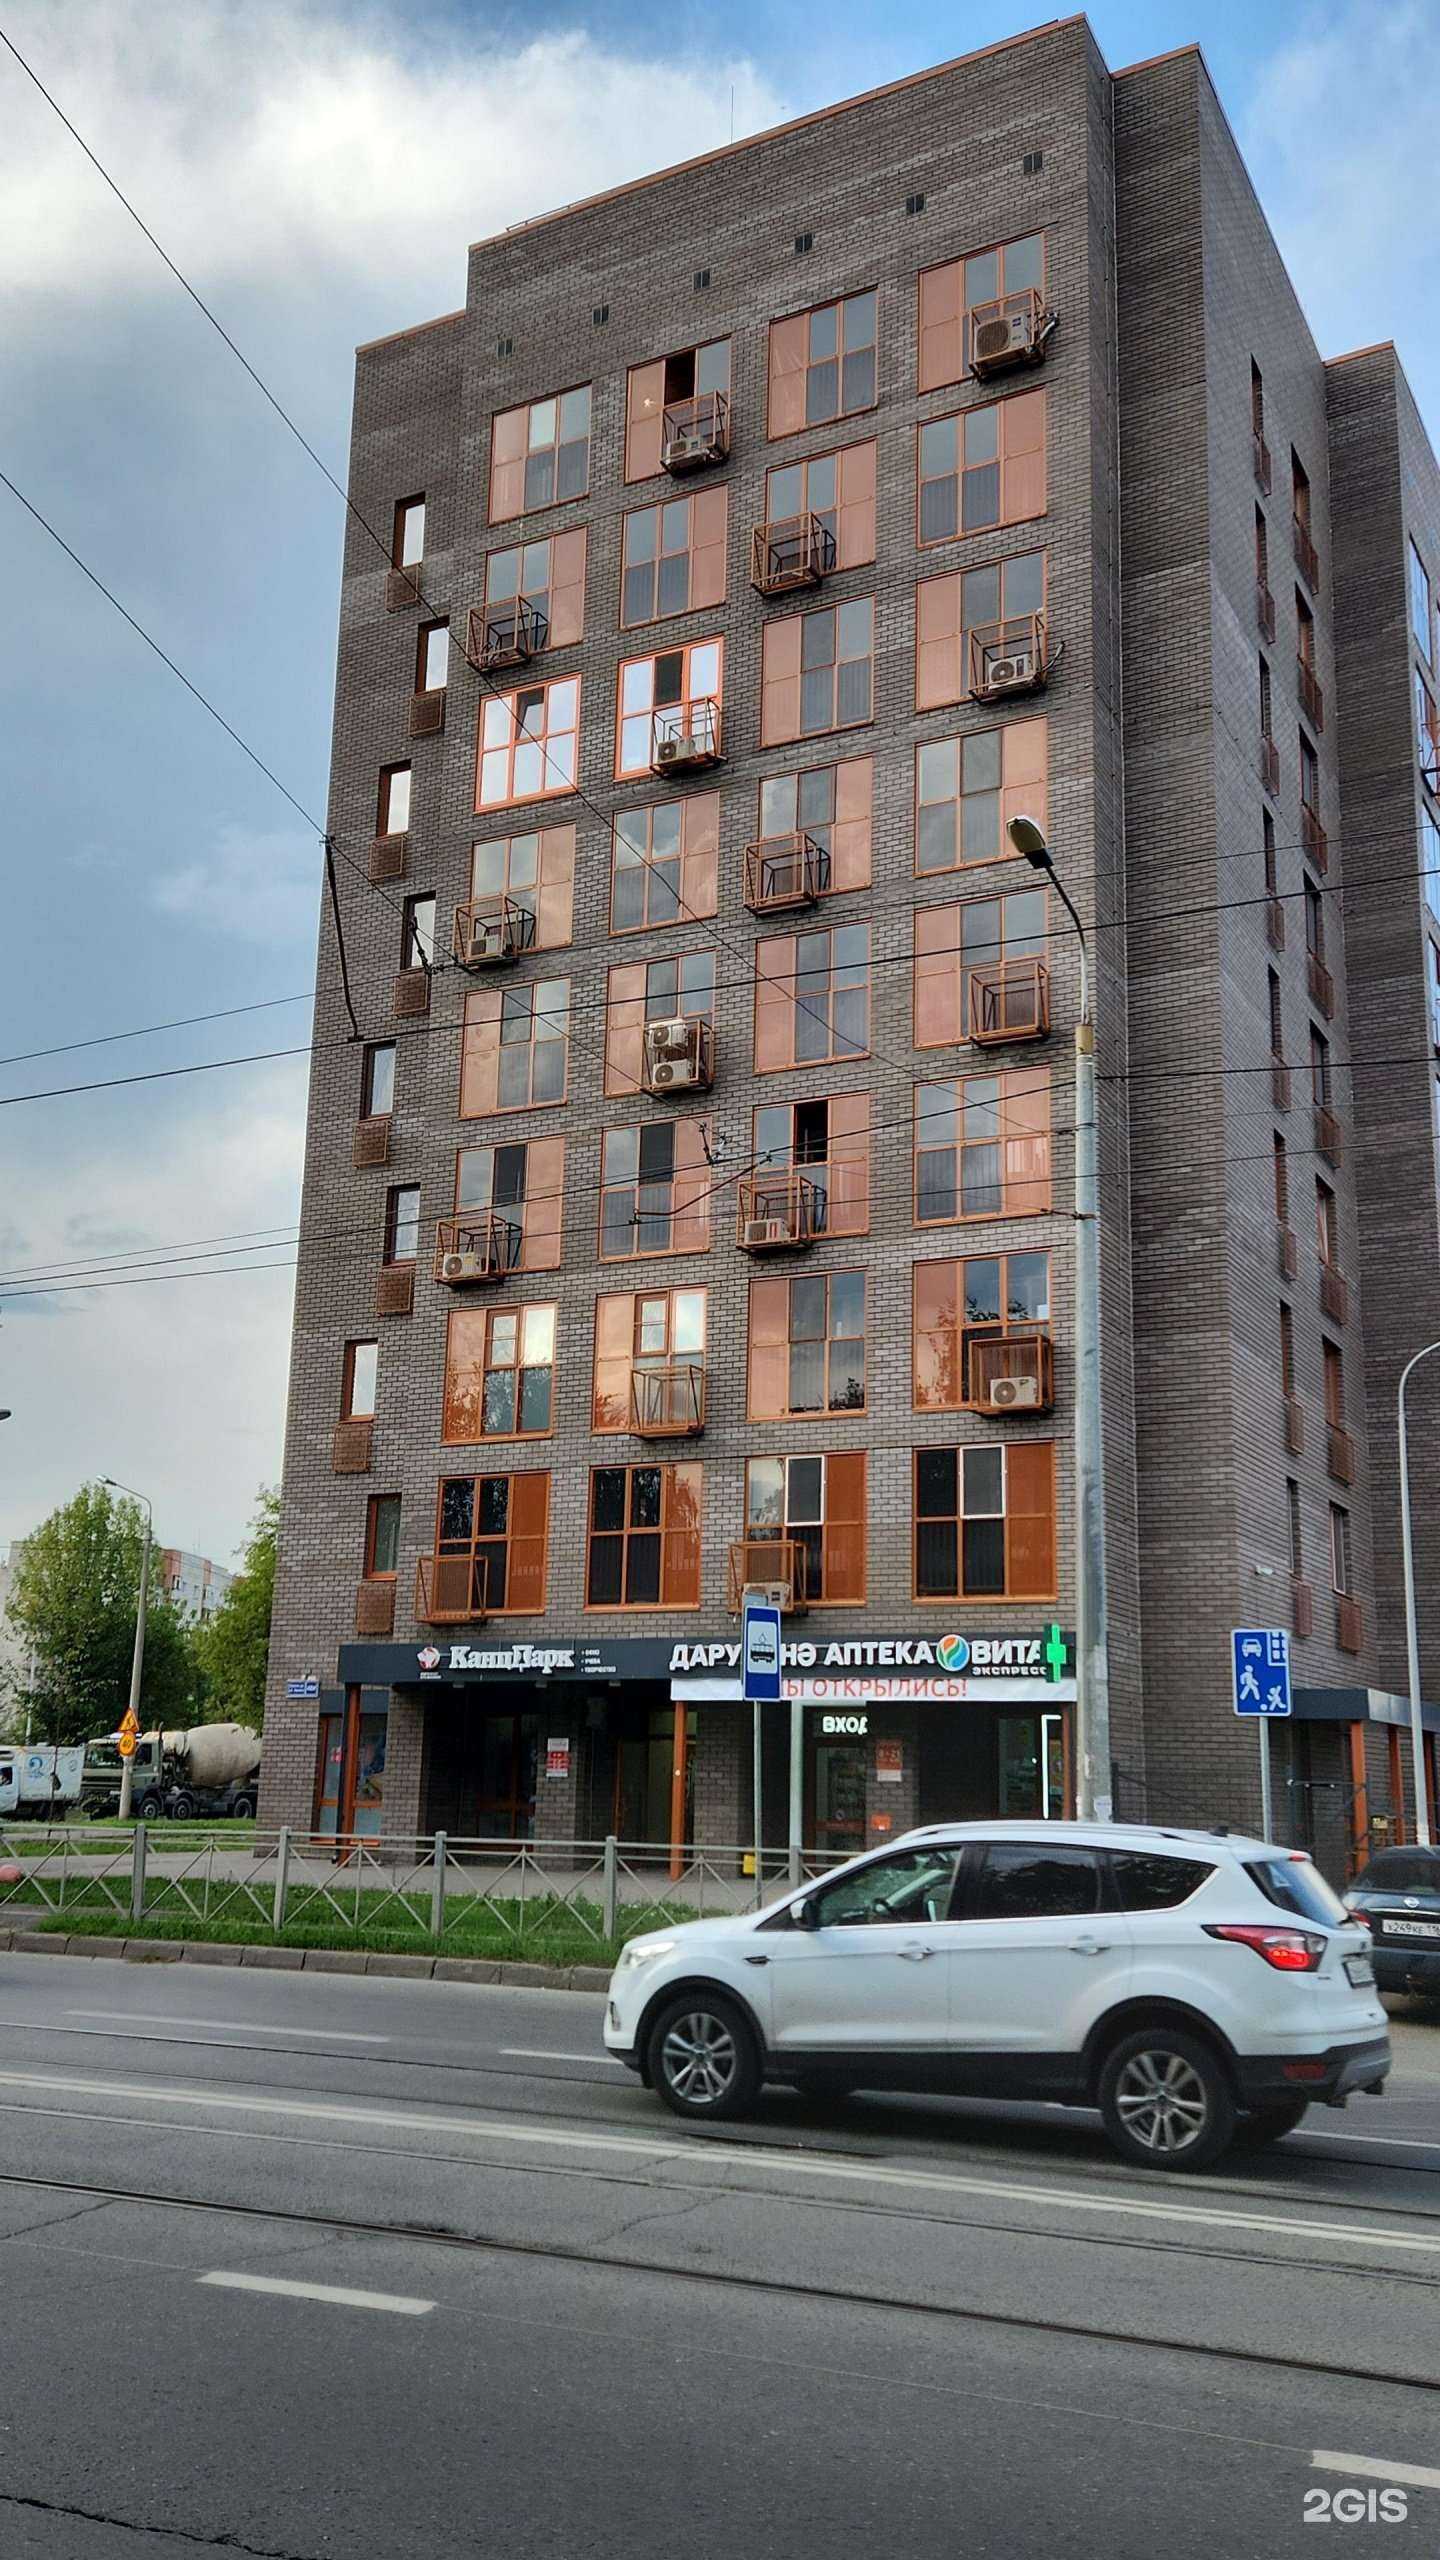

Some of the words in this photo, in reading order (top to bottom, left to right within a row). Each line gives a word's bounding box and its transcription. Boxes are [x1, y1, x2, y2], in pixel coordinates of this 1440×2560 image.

[449, 1644, 575, 1674] КанцПарк
[669, 1642, 817, 1671] ДАРУНӘ
[823, 1641, 935, 1666] АПТЕКА
[780, 1679, 804, 1697] Ы
[812, 1679, 969, 1698] ОТКРЫЛИСЬ!
